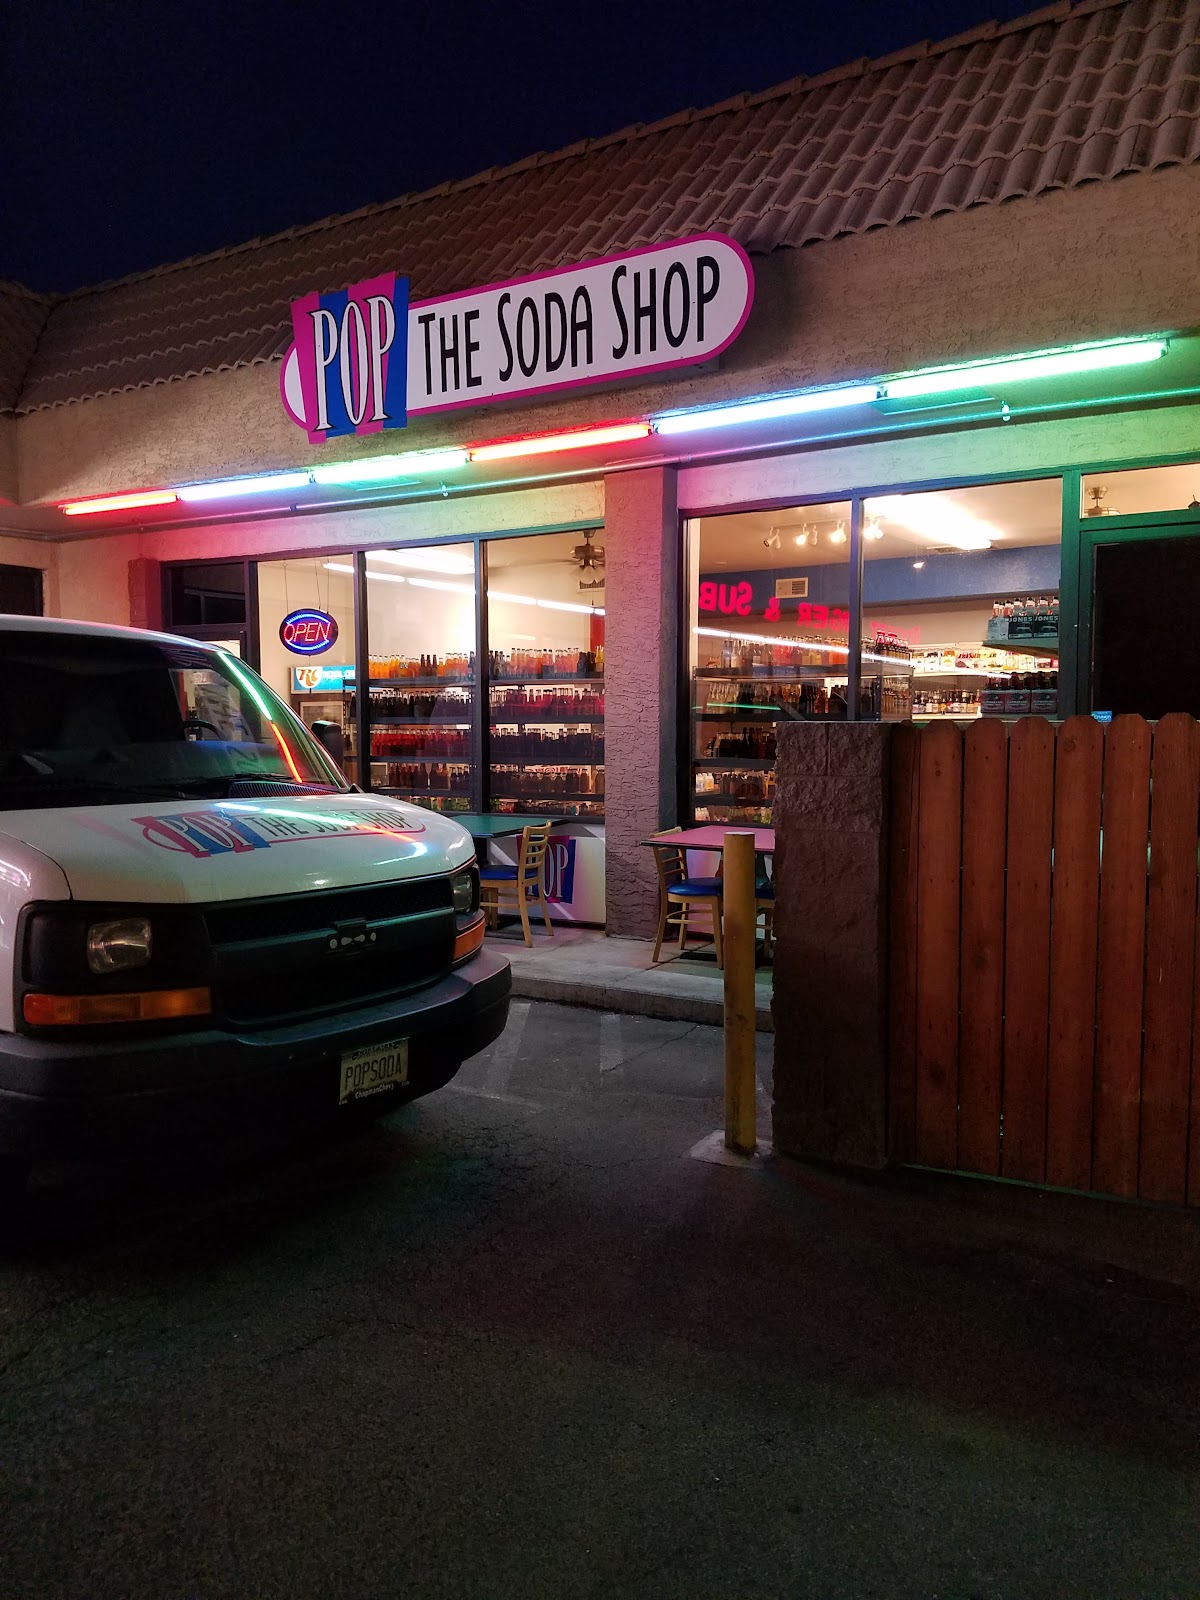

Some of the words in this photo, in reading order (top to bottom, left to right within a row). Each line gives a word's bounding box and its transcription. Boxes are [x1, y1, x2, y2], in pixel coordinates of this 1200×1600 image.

[308, 294, 396, 431] POP
[417, 310, 483, 396] THE
[497, 285, 593, 382] SODA
[611, 255, 721, 360] SHOP
[283, 621, 332, 643] OPEN
[157, 813, 253, 853] POP
[244, 812, 309, 837] THE
[345, 1053, 402, 1091] POPSODA
